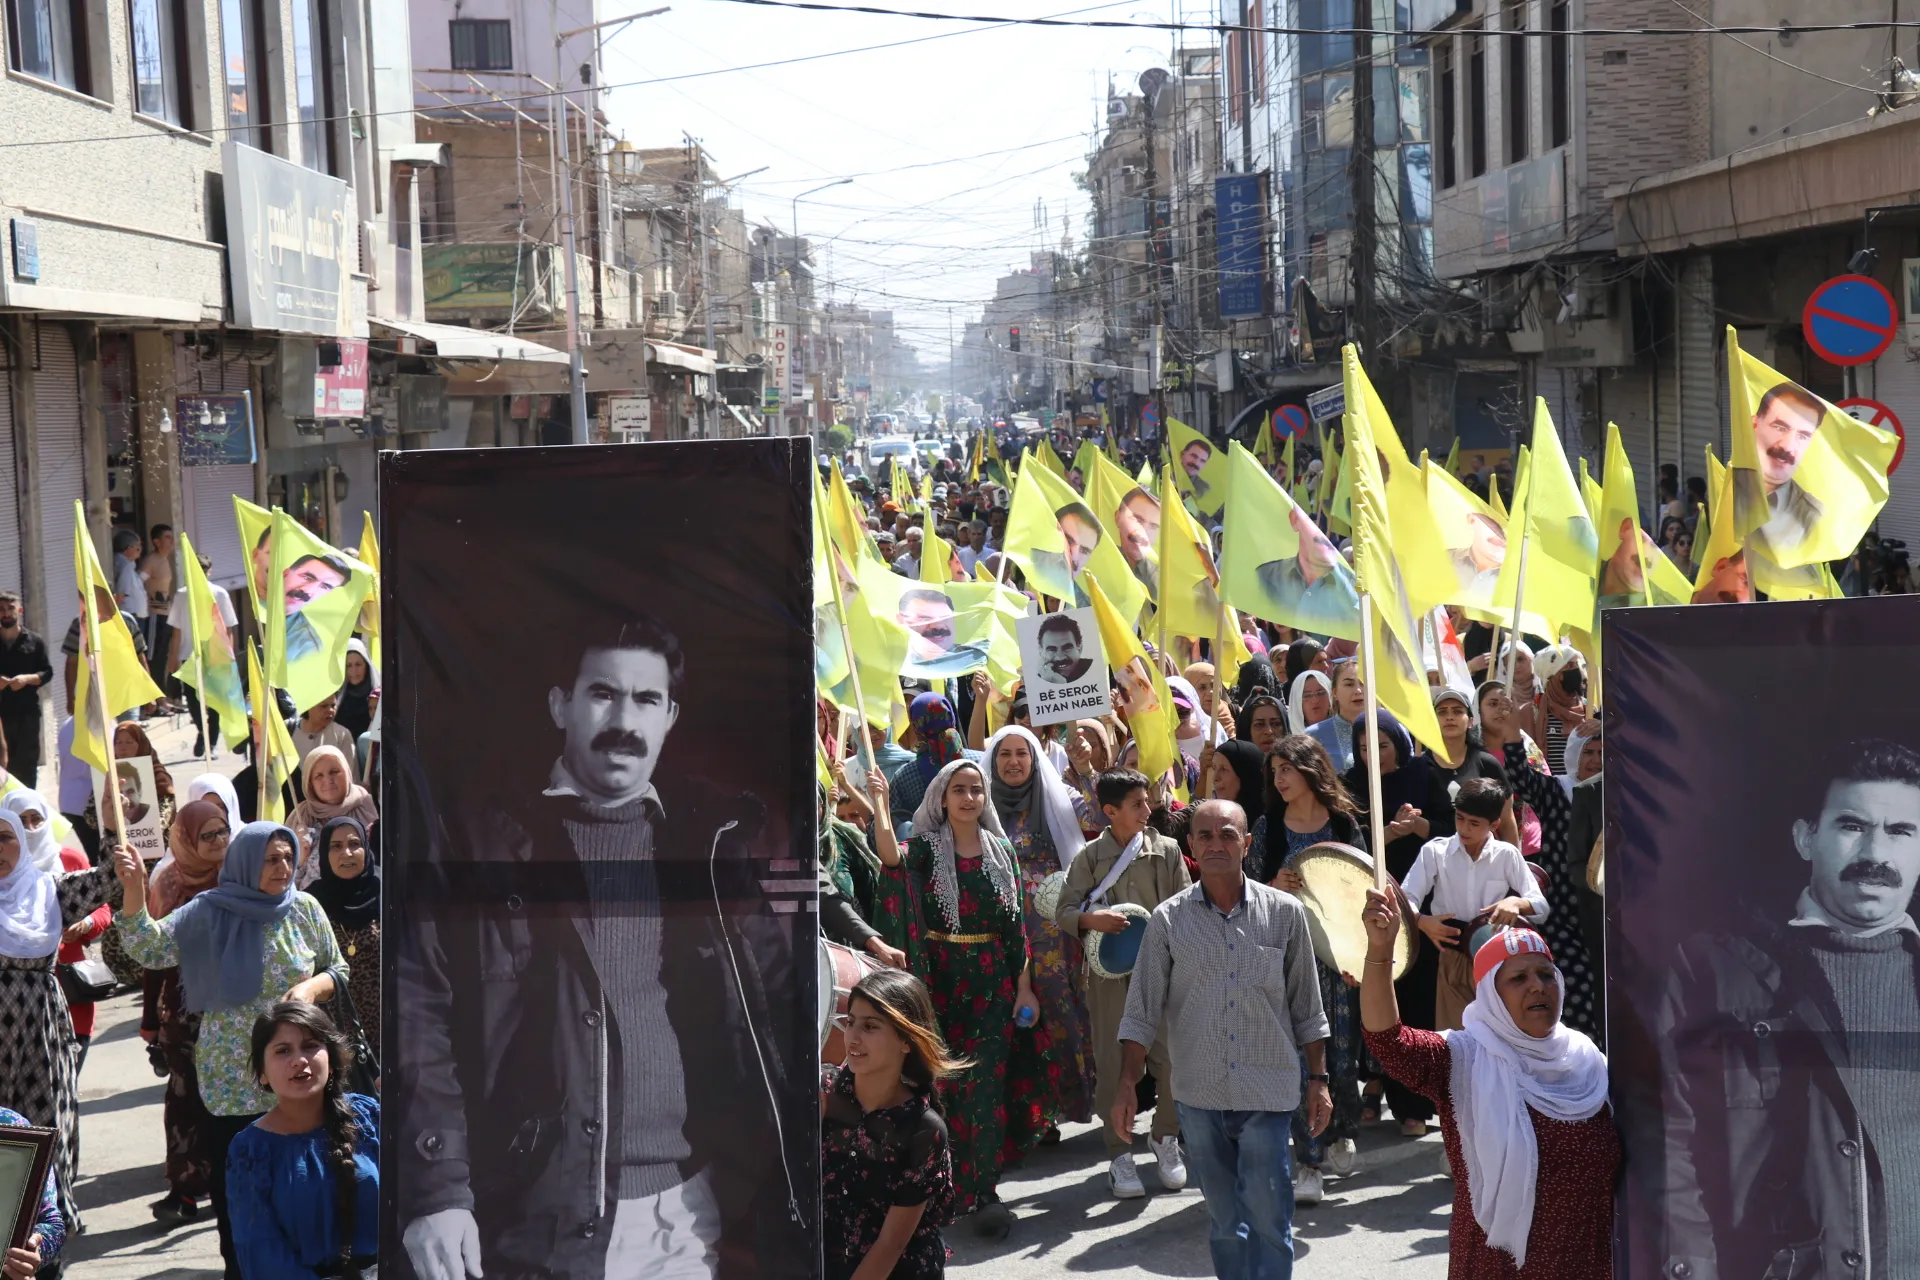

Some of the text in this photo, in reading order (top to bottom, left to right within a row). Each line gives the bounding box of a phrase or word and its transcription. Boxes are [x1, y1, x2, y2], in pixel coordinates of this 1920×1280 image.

[1230, 185, 1244, 264] HOTEL
[1058, 683, 1099, 699] SEROK
[1036, 695, 1104, 716] JIYAN NABE
[125, 827, 155, 839] SEROK
[134, 838, 159, 849] NABE
